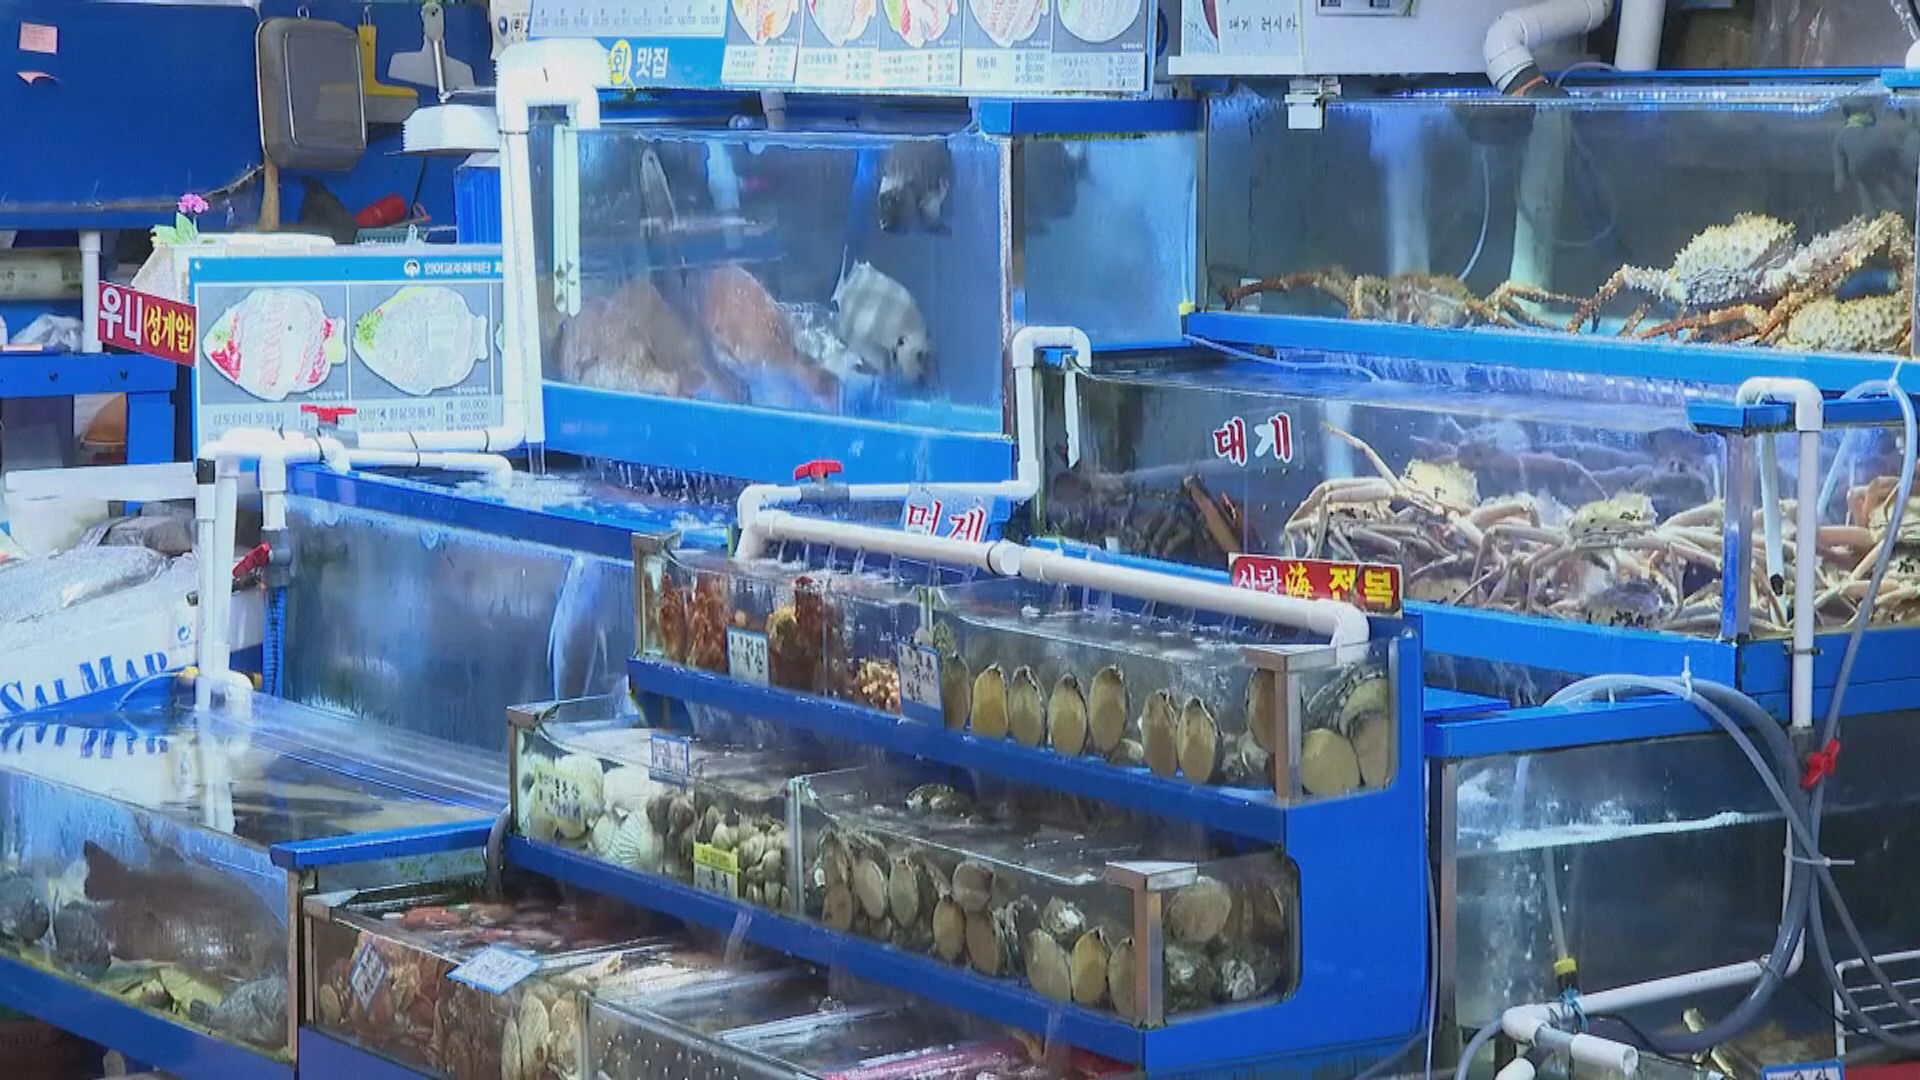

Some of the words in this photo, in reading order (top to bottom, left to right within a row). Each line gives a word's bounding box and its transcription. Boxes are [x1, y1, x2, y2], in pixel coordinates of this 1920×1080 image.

[1261, 12, 1298, 34] 러시아
[636, 46, 669, 80] 맛집
[1212, 412, 1293, 467] 대게
[1329, 566, 1394, 609] 전복
